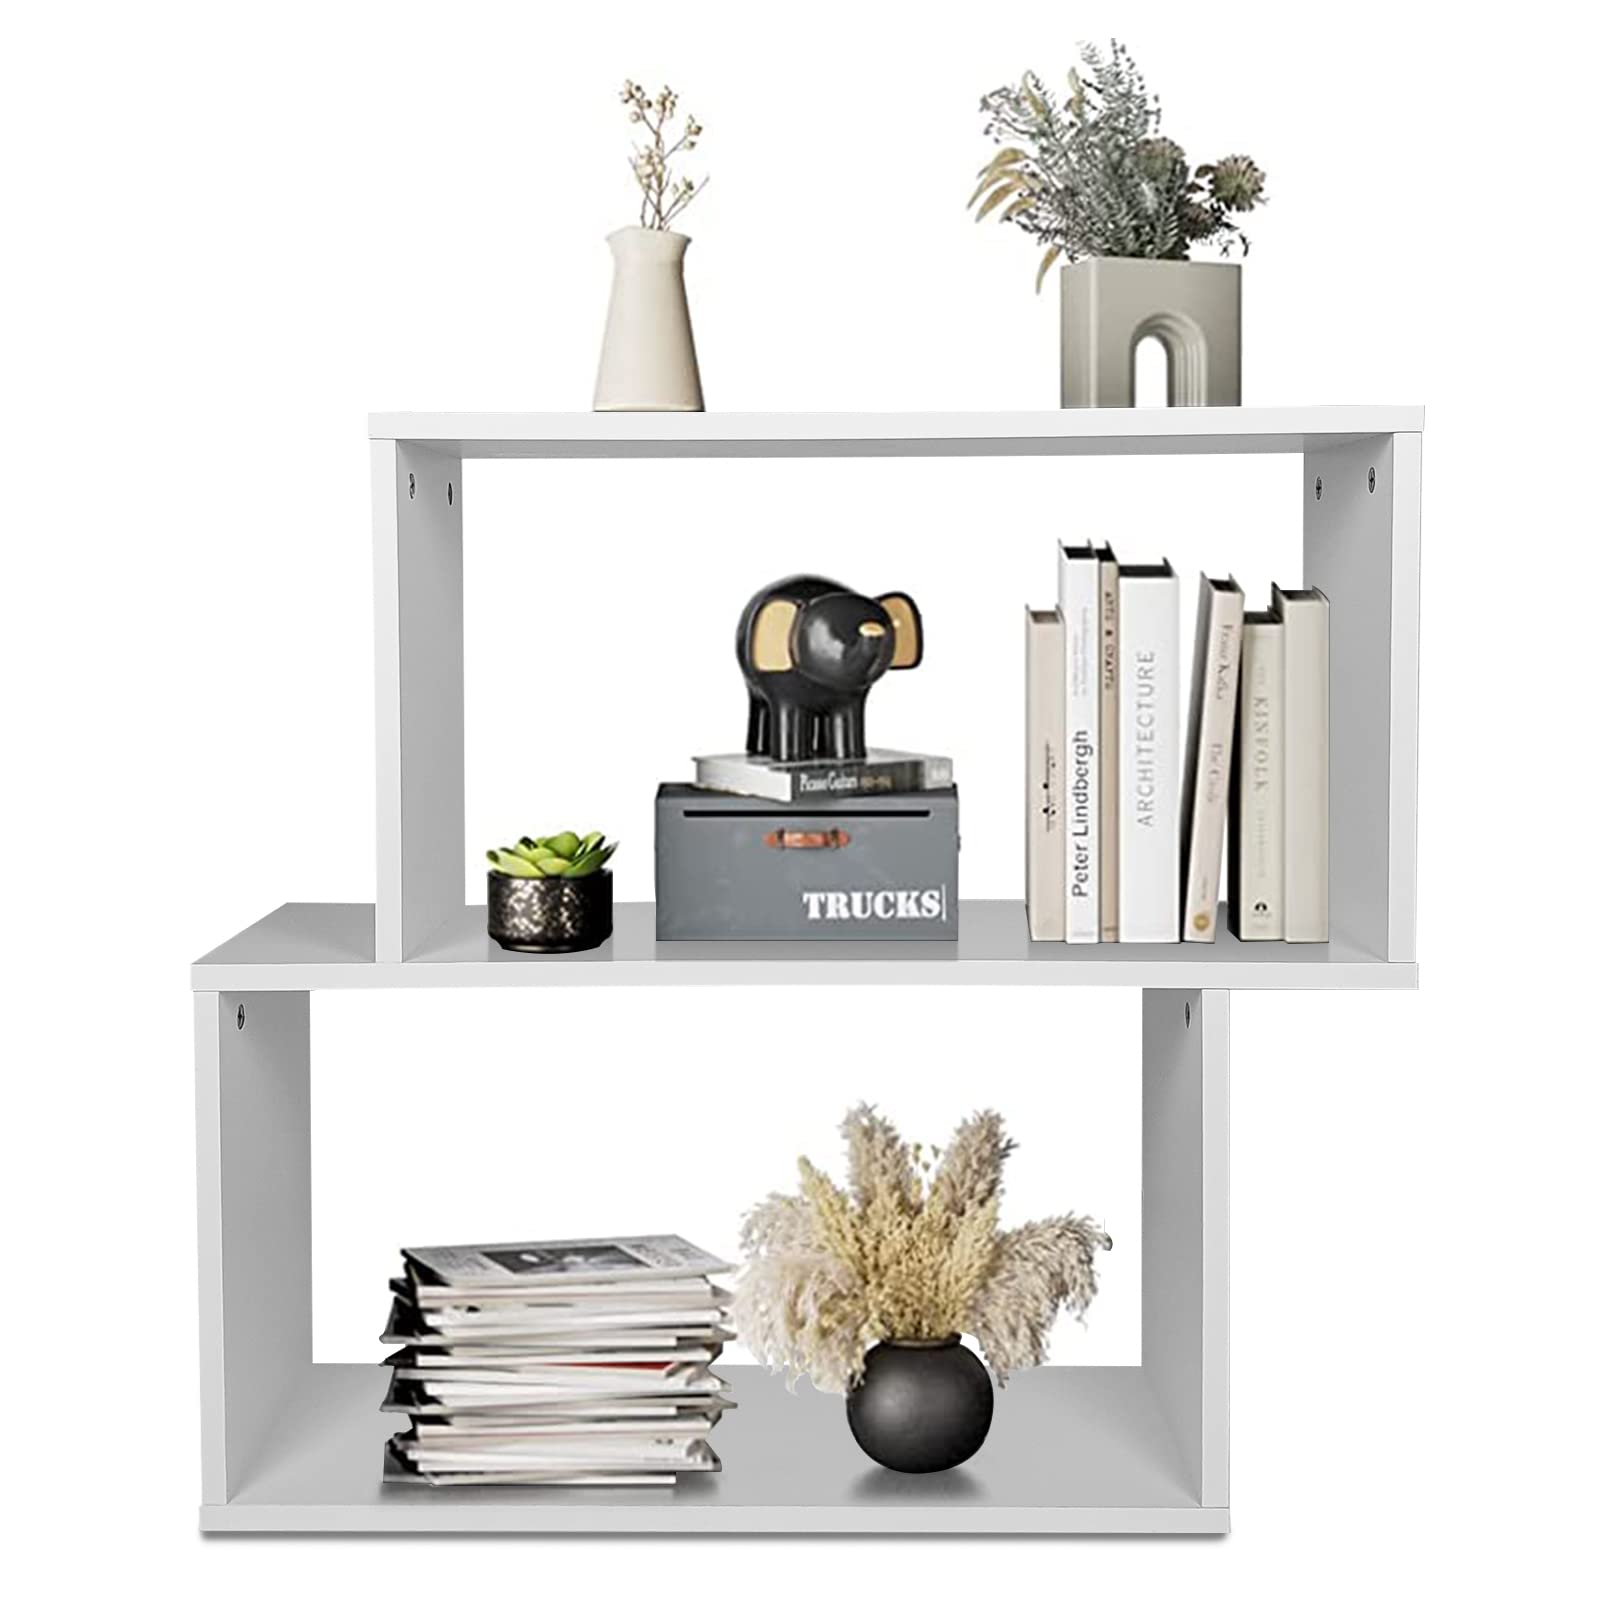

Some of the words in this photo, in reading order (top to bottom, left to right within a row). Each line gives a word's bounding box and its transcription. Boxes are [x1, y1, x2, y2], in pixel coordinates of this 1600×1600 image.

[1071, 730, 1094, 836] Lindbergh
[1137, 651, 1155, 827] ARCHITECTURE
[1254, 697, 1268, 791] KINFOLK
[803, 889, 941, 920] TRUCKS
[1071, 843, 1089, 898] Peter
